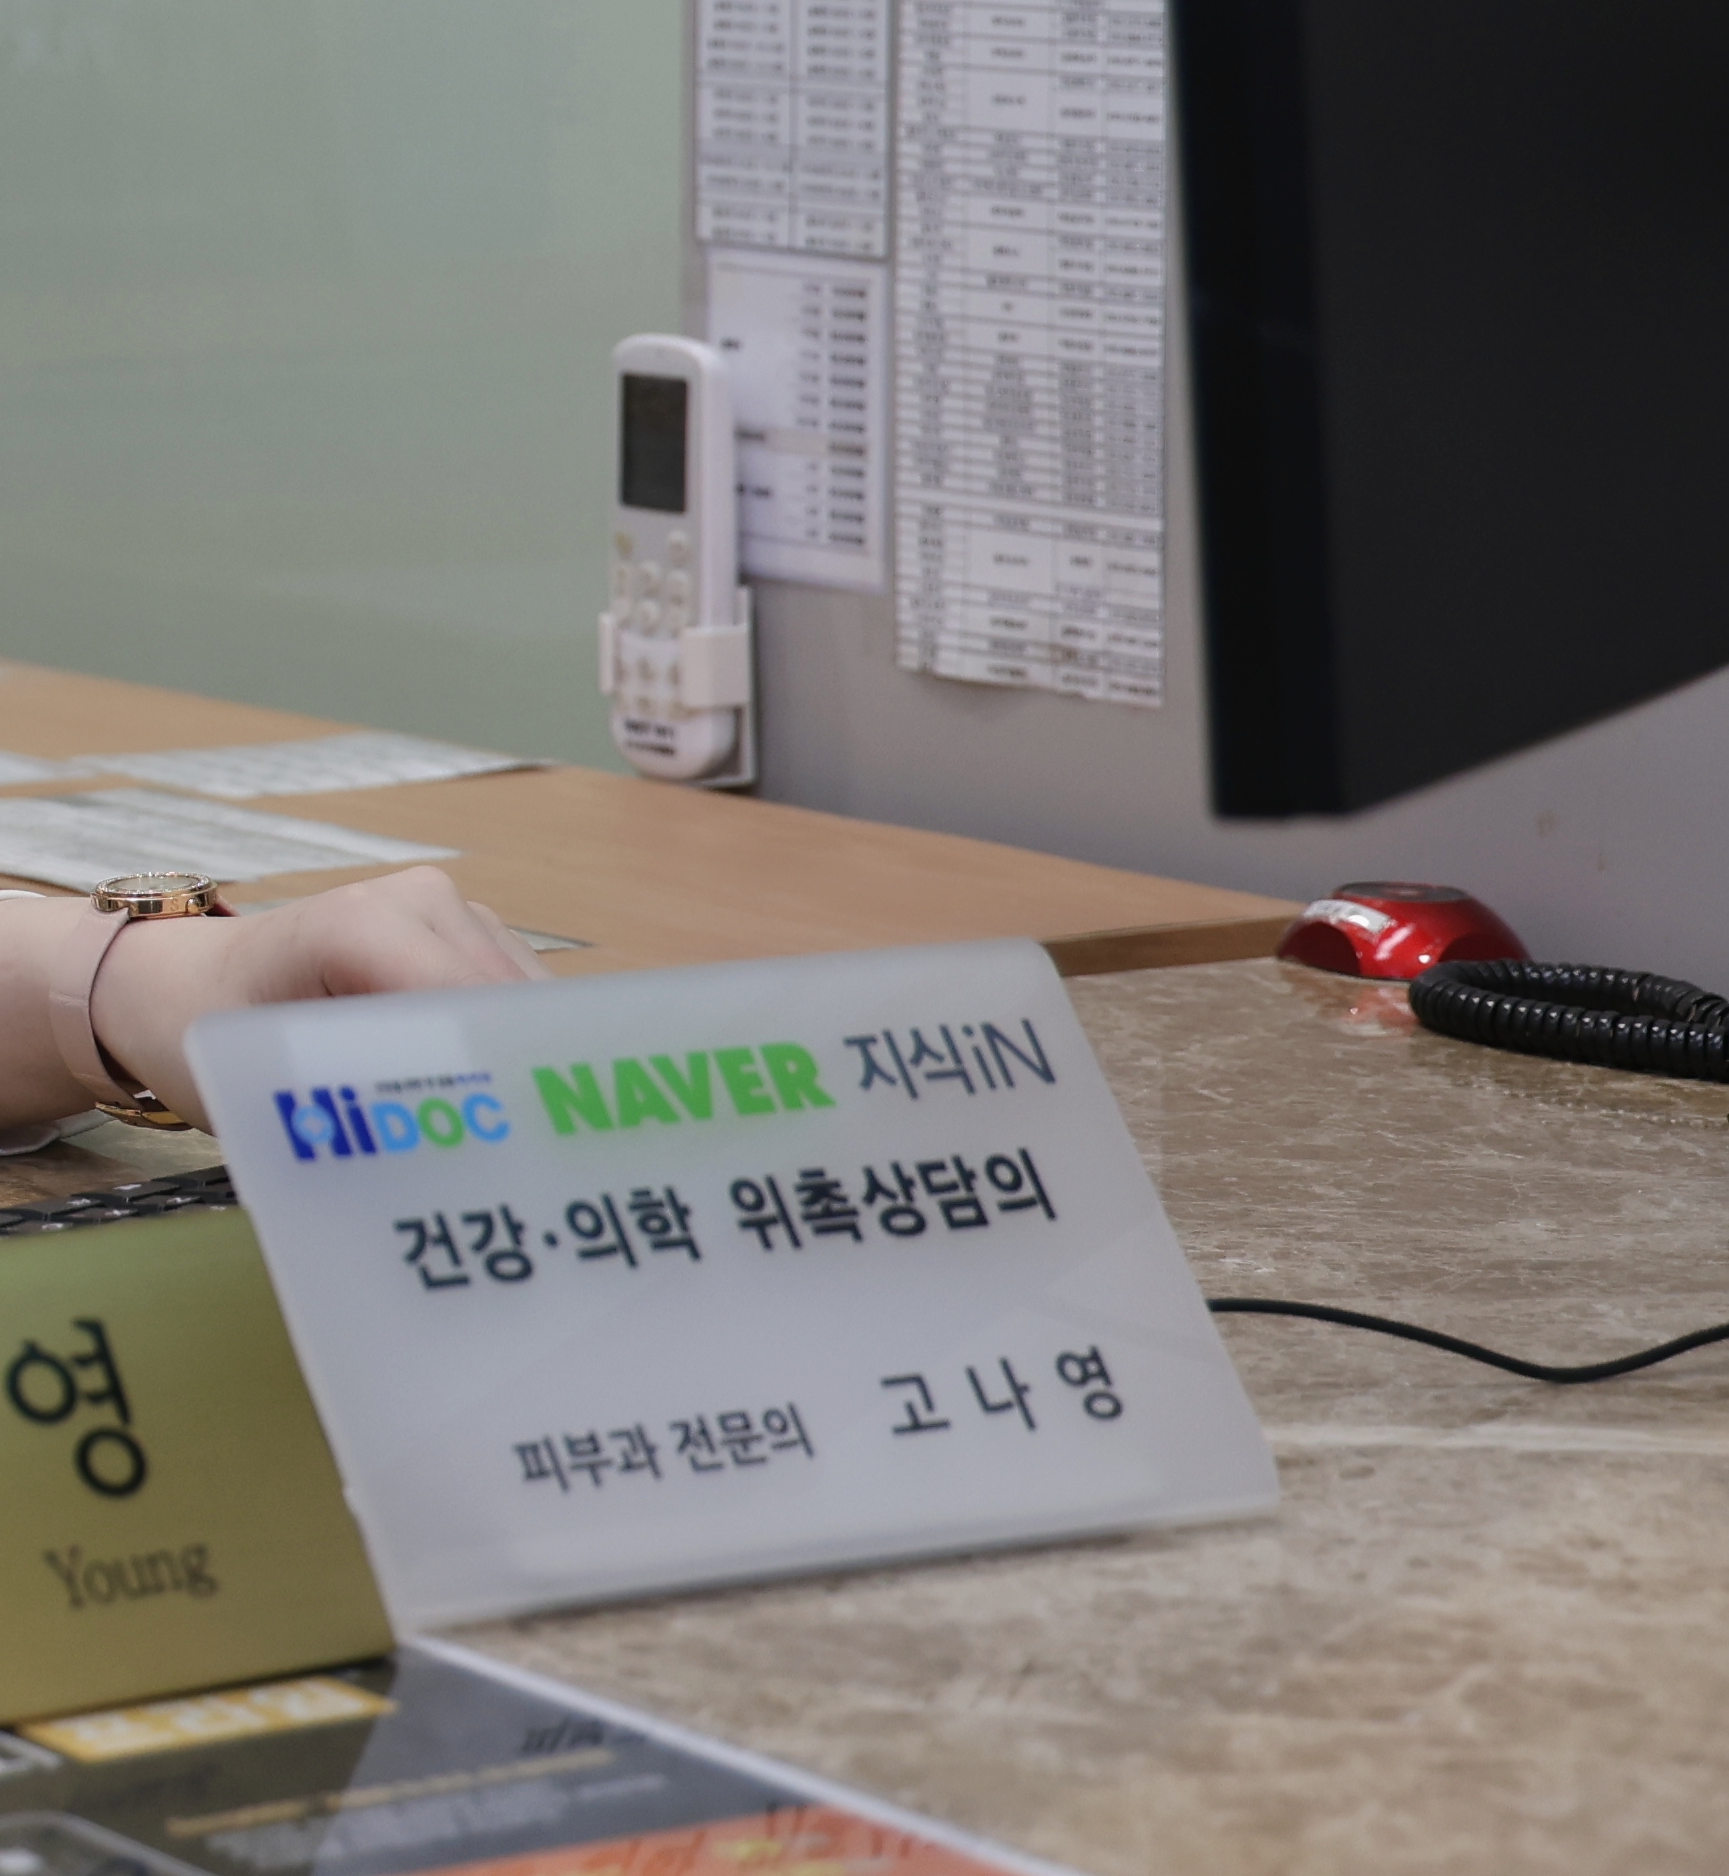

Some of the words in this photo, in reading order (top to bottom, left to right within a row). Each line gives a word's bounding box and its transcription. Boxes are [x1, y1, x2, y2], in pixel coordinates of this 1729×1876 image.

[533, 1042, 835, 1135] NAVER
[842, 1018, 1057, 1102] 지식iN
[391, 1184, 704, 1293] 건강·의학
[728, 1145, 1059, 1255] 위촉상담의
[4, 1318, 148, 1500] 영
[511, 1423, 663, 1494] 피부과
[668, 1400, 816, 1476] 전문의
[42, 1542, 219, 1611] Young
